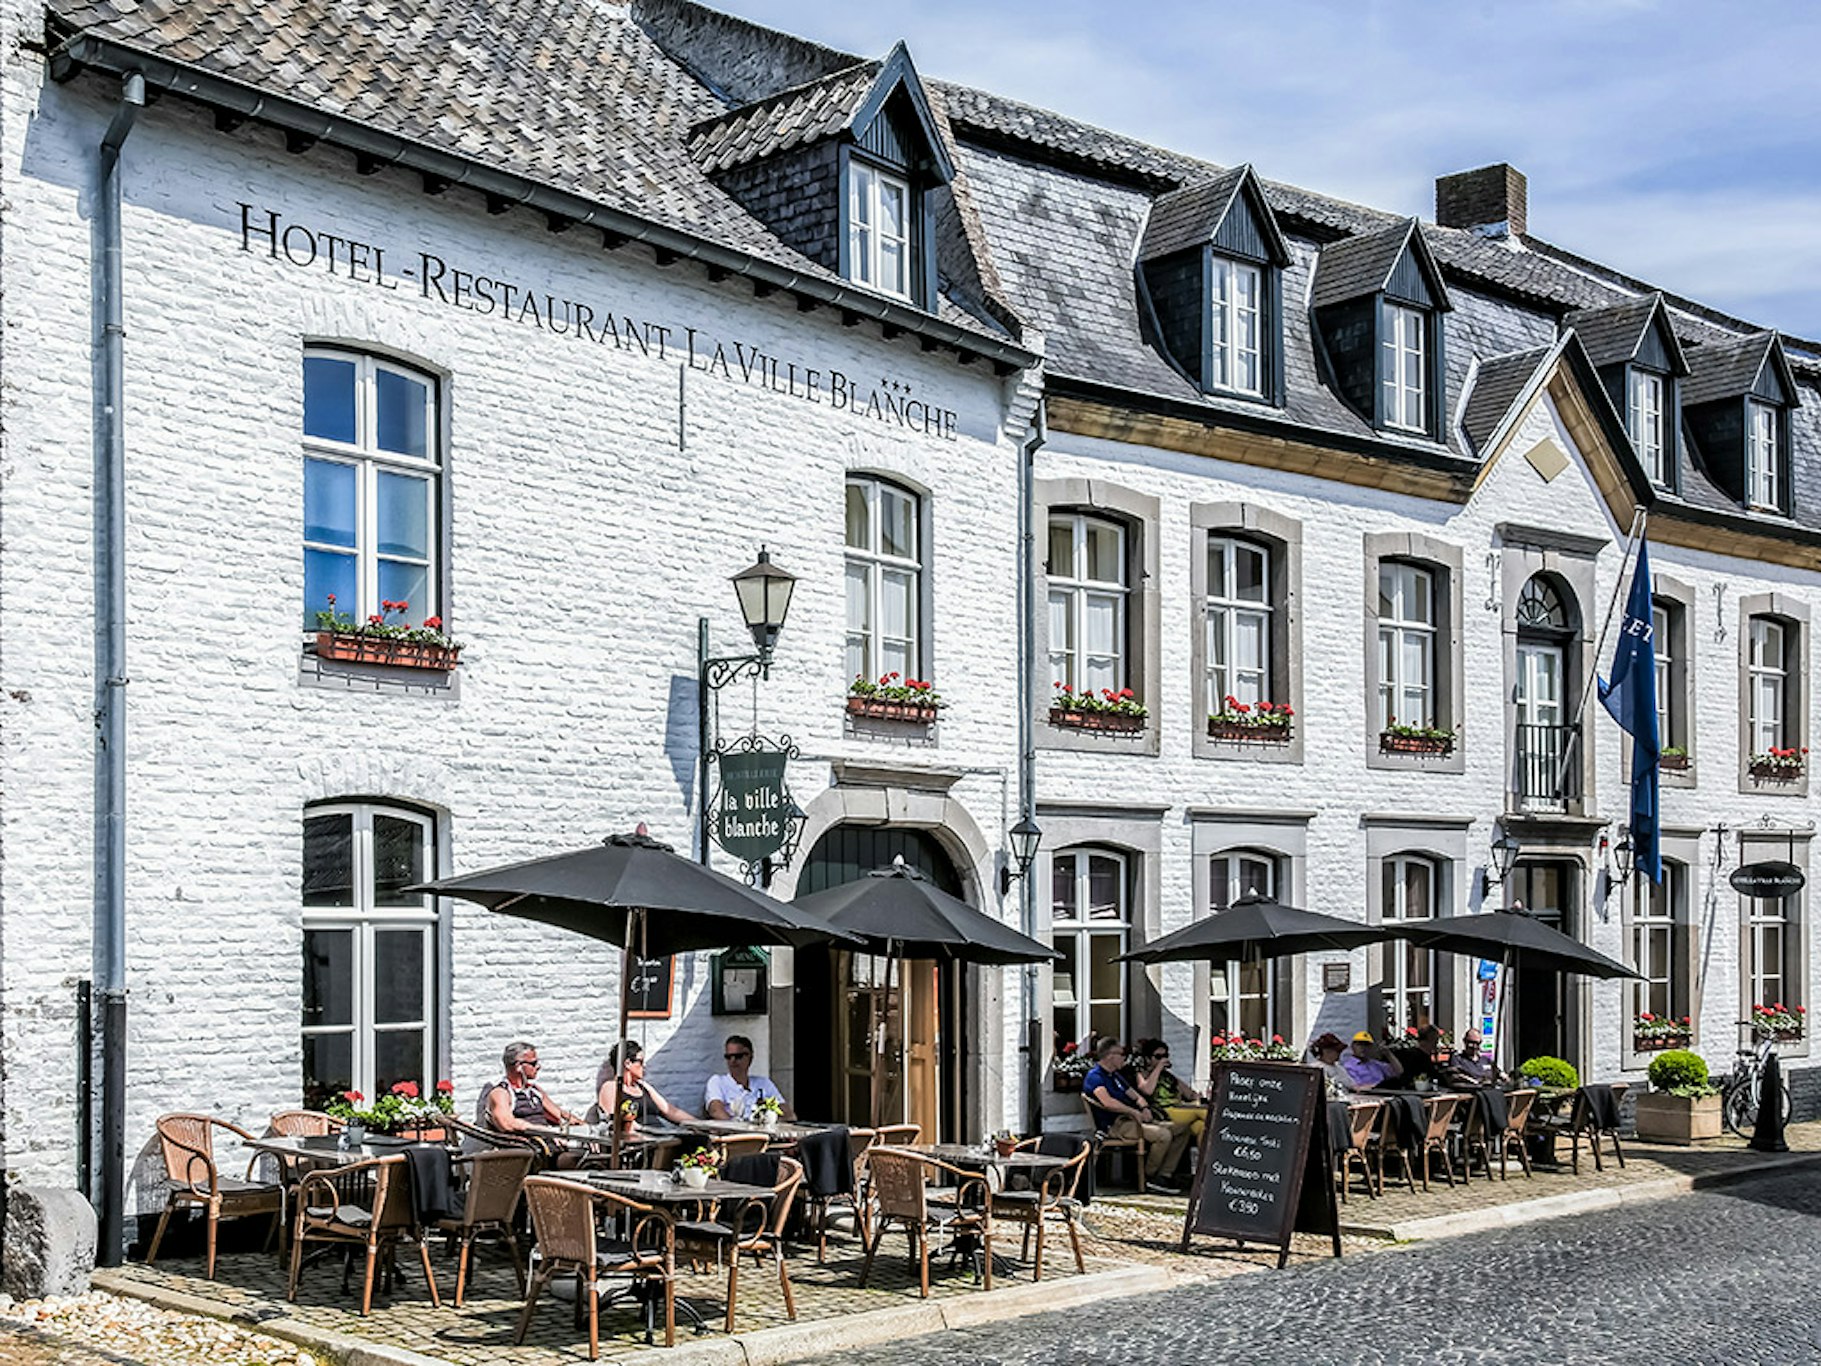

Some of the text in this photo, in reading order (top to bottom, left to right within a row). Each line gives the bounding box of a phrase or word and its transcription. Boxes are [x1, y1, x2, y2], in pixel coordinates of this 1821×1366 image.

[829, 369, 957, 441] BLANCHE
[724, 789, 738, 811] la
[725, 813, 779, 838] blanche
